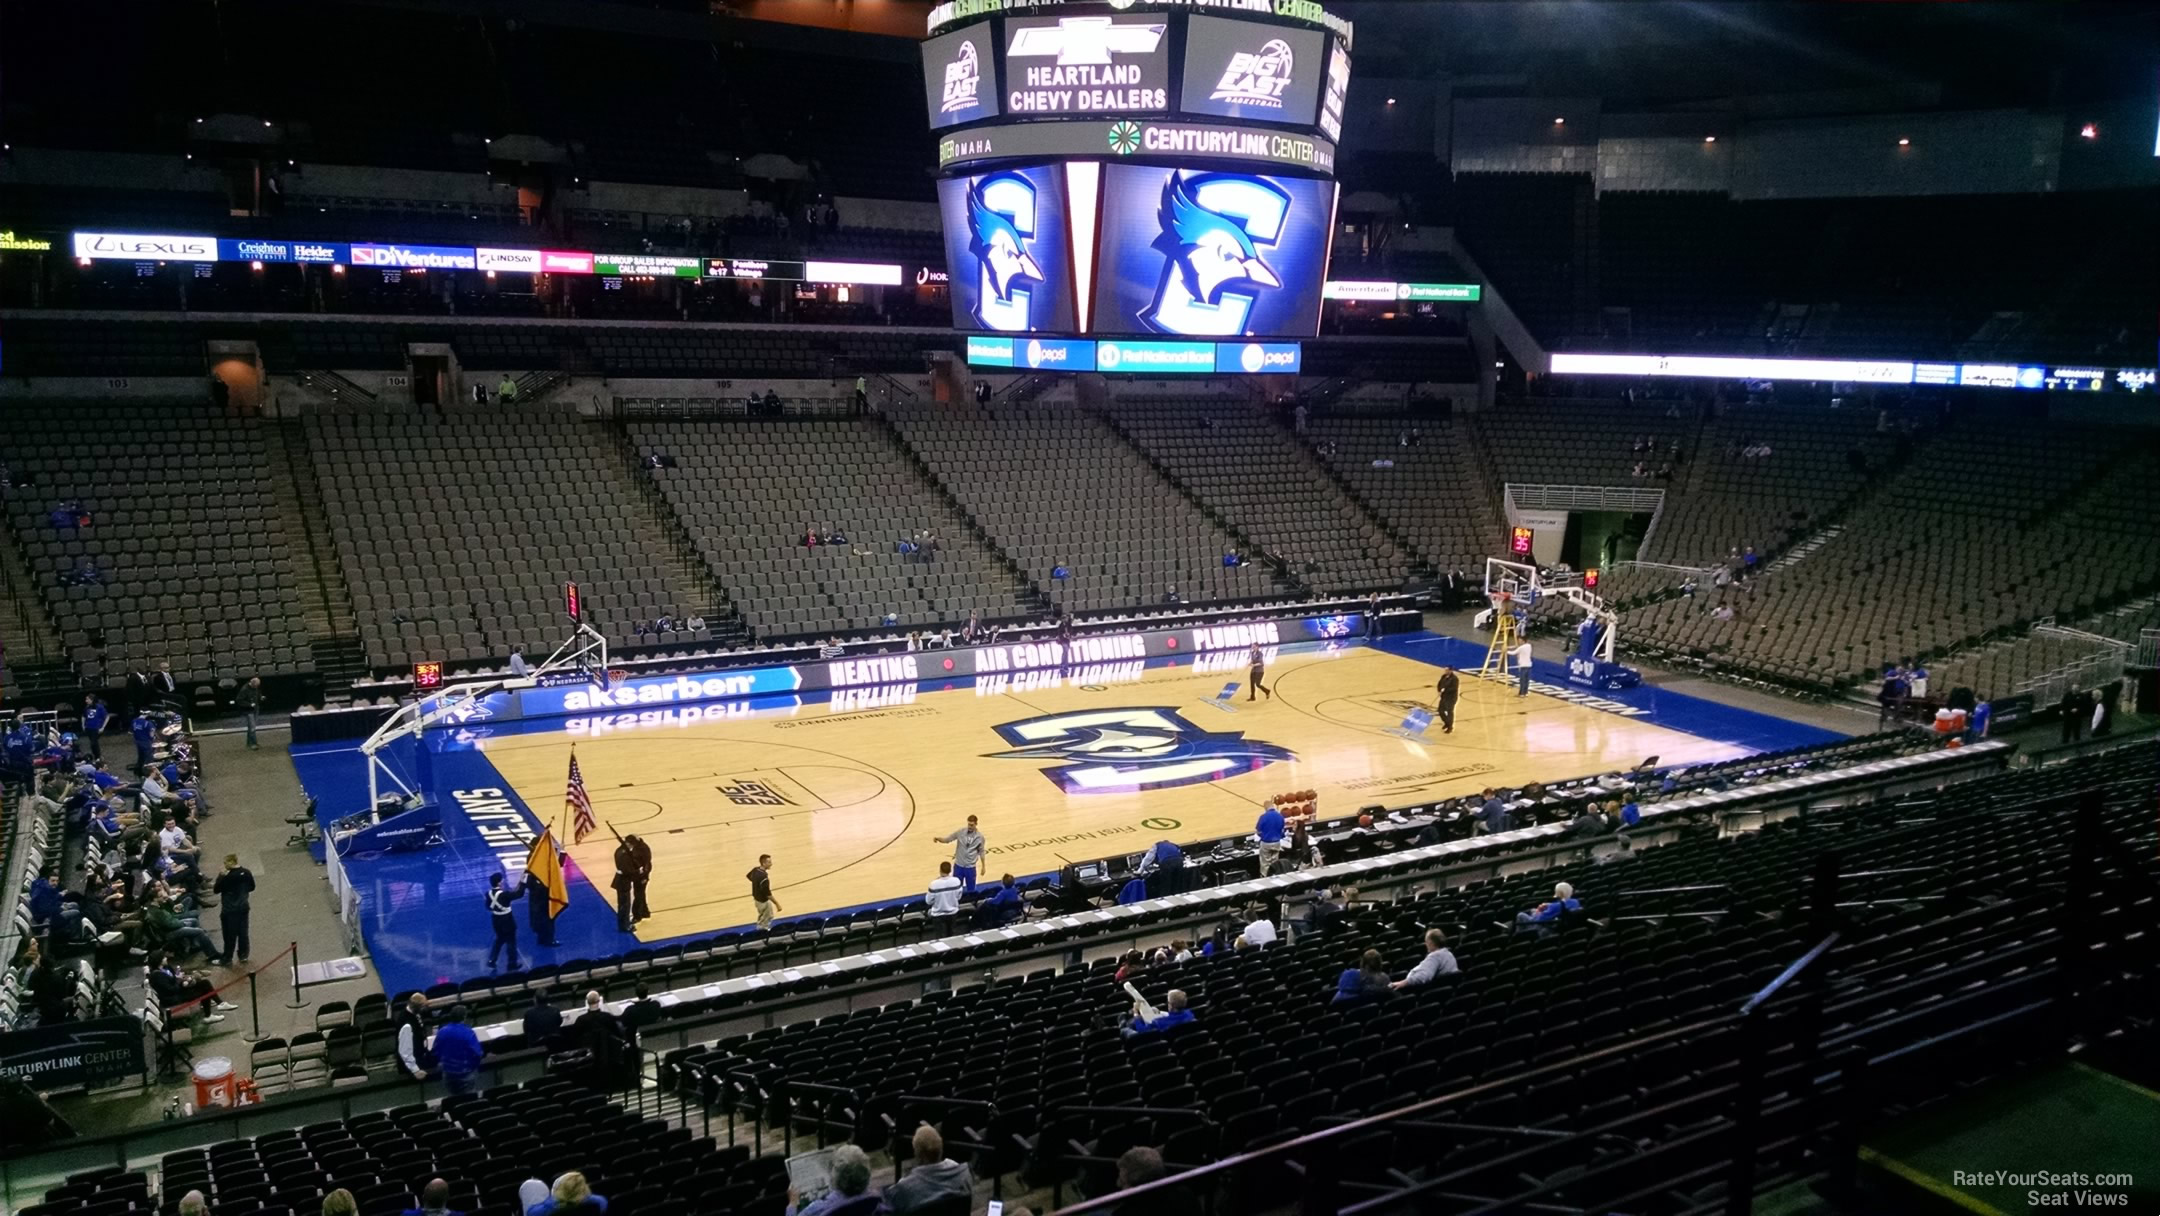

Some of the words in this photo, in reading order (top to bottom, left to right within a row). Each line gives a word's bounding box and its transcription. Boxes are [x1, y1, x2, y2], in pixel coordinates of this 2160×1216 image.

[945, 59, 971, 83] BIG
[1226, 52, 1281, 76] BIG
[1027, 65, 1141, 86] HEARTLAND
[1216, 71, 1291, 95] EAST
[943, 76, 979, 102] EAST
[1010, 90, 1072, 110] CHEVY
[1078, 88, 1166, 110] DEALERS
[1225, 96, 1282, 108] BASKETBALL
[955, 139, 992, 157] OMAHA
[1145, 127, 1269, 155] CENTURYLINK
[1272, 136, 1313, 161] CENTER
[121, 243, 206, 255] LEXUS
[238, 243, 286, 255] Creighton
[294, 246, 335, 257] Heider
[374, 247, 474, 268] DiVentures
[490, 255, 532, 263] LINDSAY
[594, 256, 608, 264] FOR
[609, 257, 633, 265] GROUP
[634, 258, 655, 267] SALES
[656, 258, 699, 267] INFORMATION
[618, 265, 635, 274] CALL
[1040, 347, 1065, 362] pepsi
[1264, 350, 1294, 366] pepsi
[109, 379, 128, 389] 103
[389, 376, 406, 386] 104
[717, 381, 731, 389] 105
[1515, 537, 1528, 551] 35
[1193, 622, 1279, 651] PLUMBING
[829, 656, 918, 686] HEATING
[975, 648, 1009, 672] AIR
[1012, 635, 1145, 669] CONDTIONING
[417, 665, 439, 674] 36:34
[421, 673, 436, 684] 35
[563, 677, 750, 711] aksarben
[798, 713, 888, 726] CENTURYLINK
[1097, 825, 1137, 838] First
[1006, 832, 1097, 852] National
[0, 1055, 81, 1078] ENTURYLINK
[84, 1049, 131, 1065] CENTER
